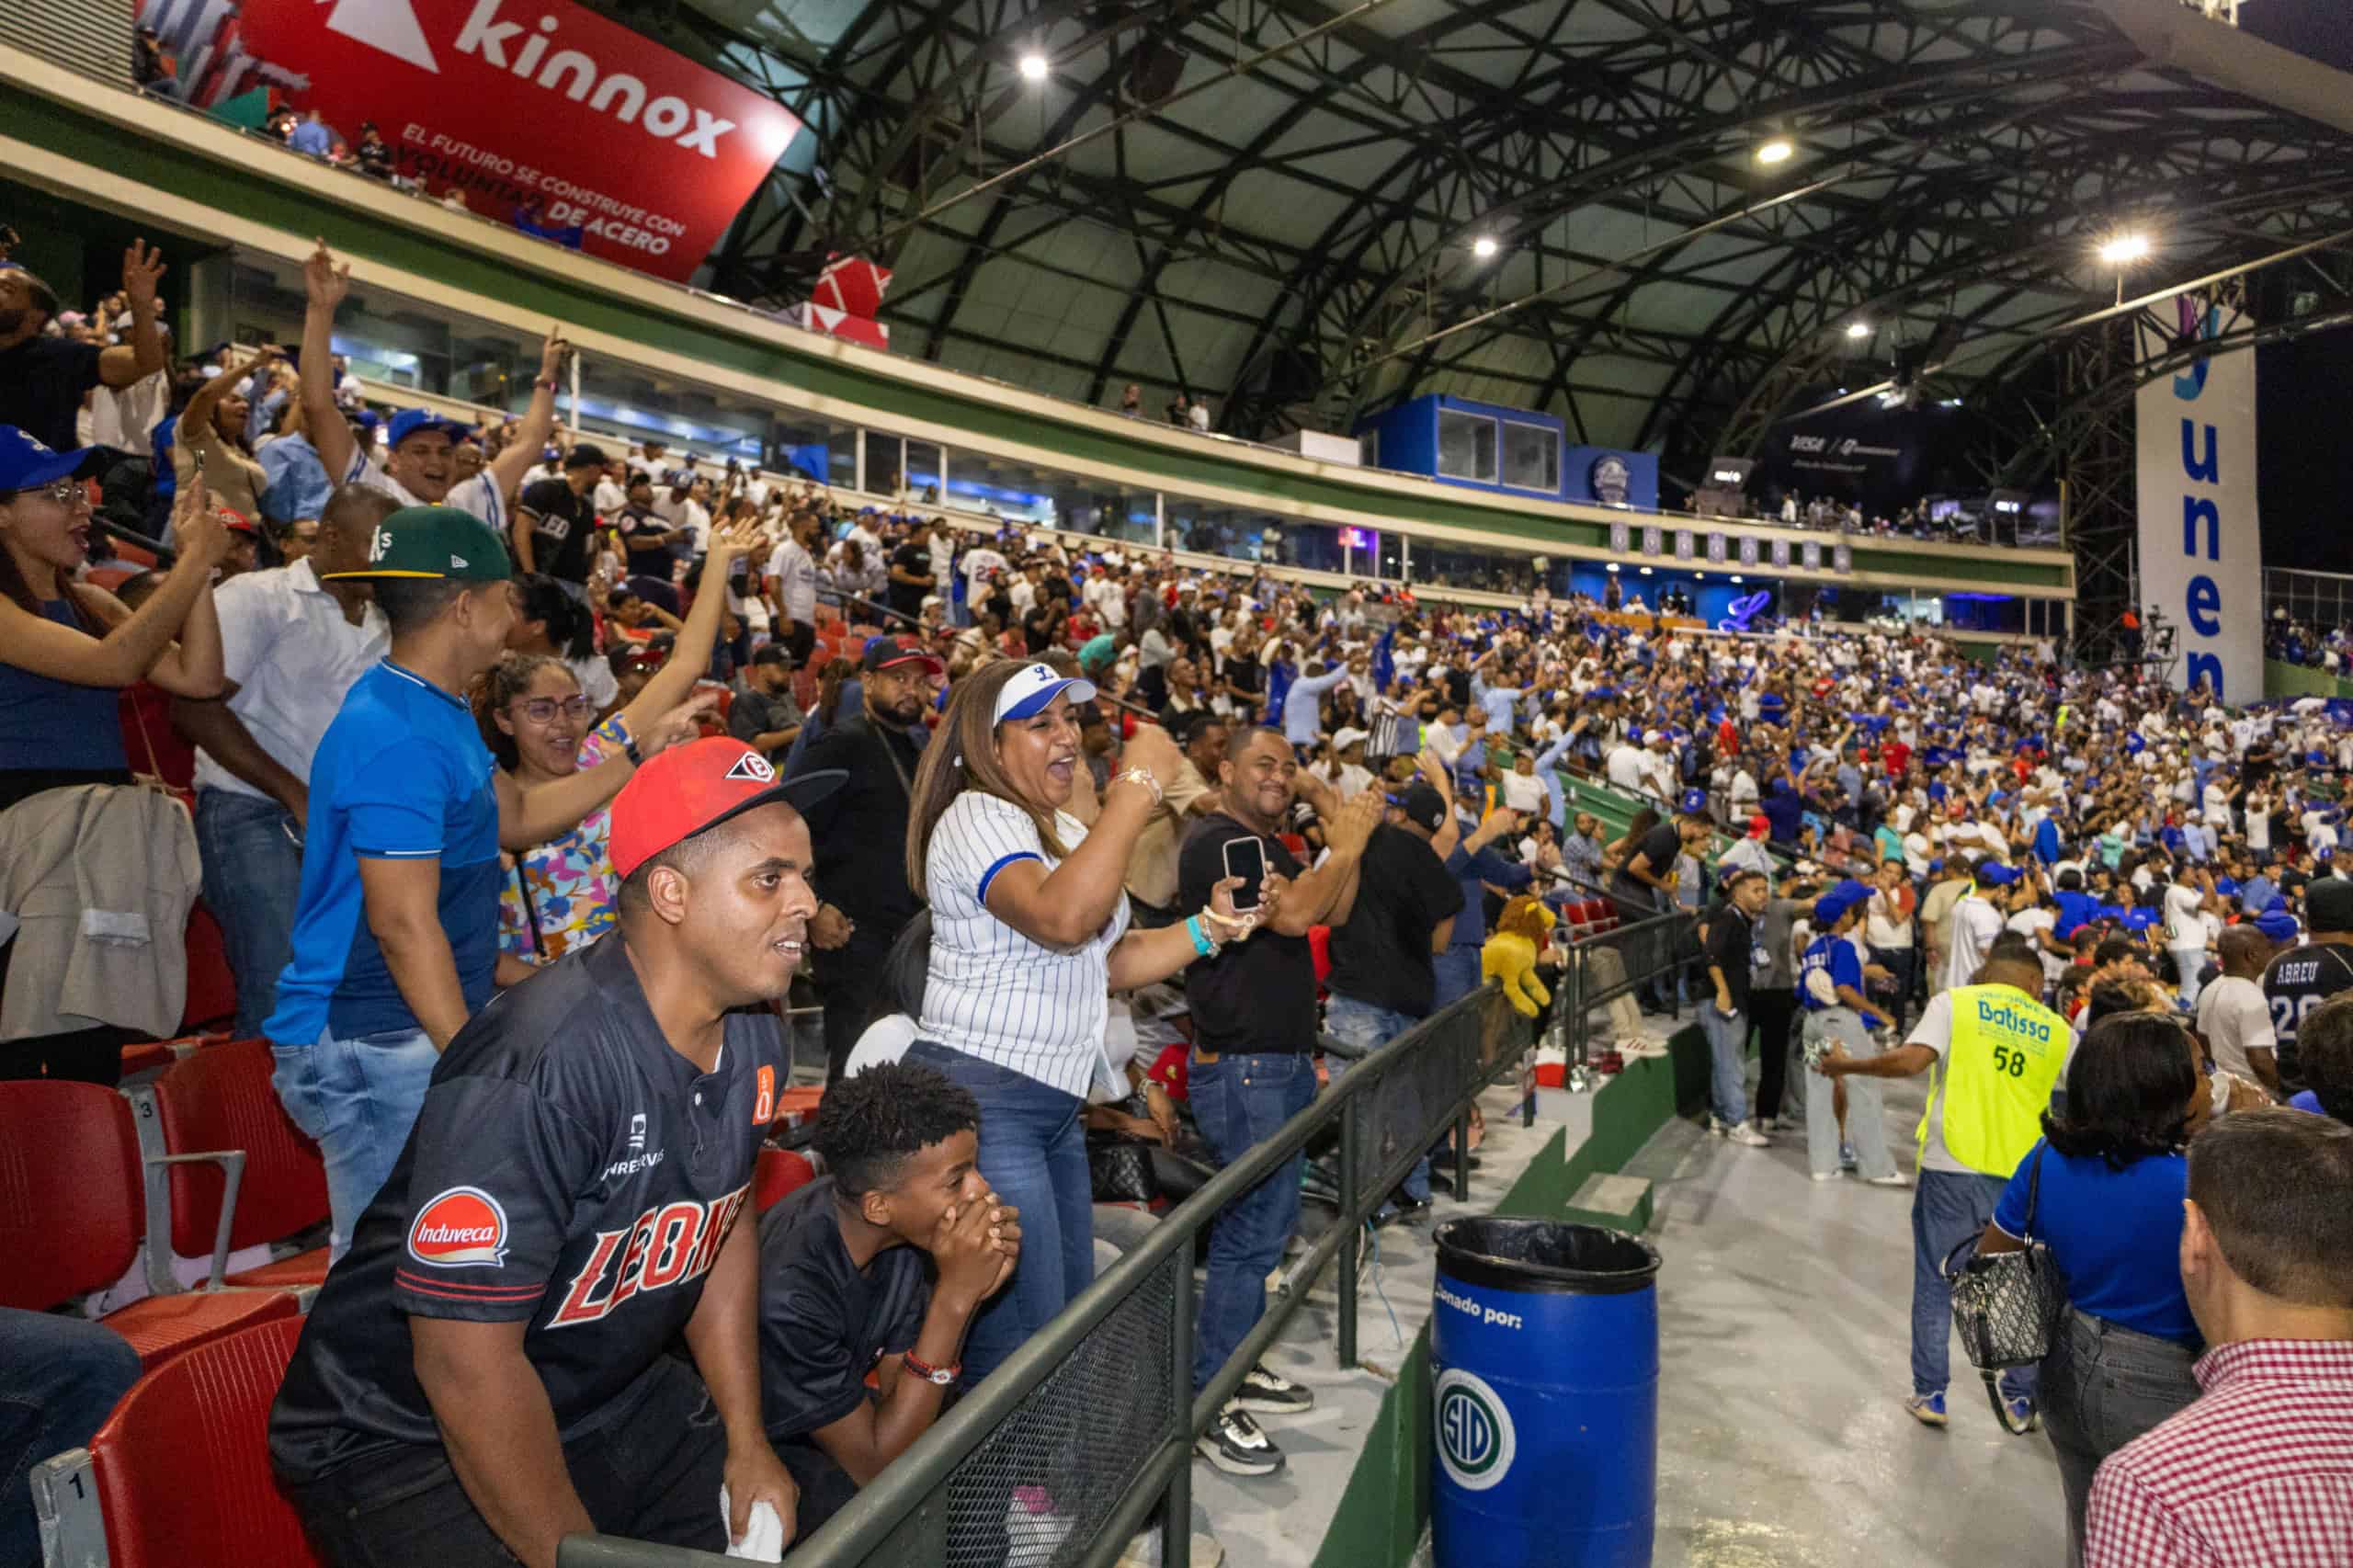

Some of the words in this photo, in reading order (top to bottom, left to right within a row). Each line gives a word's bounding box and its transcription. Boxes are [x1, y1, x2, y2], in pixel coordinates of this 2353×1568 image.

[454, 0, 735, 158] kinnox
[402, 122, 427, 145] EL
[430, 133, 514, 175] FUTURO
[514, 165, 543, 186] SE
[540, 176, 647, 224] CONSTRUYE
[645, 213, 688, 237] CON
[548, 200, 588, 226] DE
[584, 217, 670, 255] ACERO
[2276, 961, 2319, 984] ABREU
[1978, 1000, 2051, 1041] Batissa
[1994, 1045, 2026, 1077] 58
[140, 1102, 153, 1119] 3
[417, 1222, 495, 1243] Induveca
[544, 1182, 750, 1330] LEON
[1484, 1307, 1522, 1330] por:
[68, 1472, 85, 1499] 1
